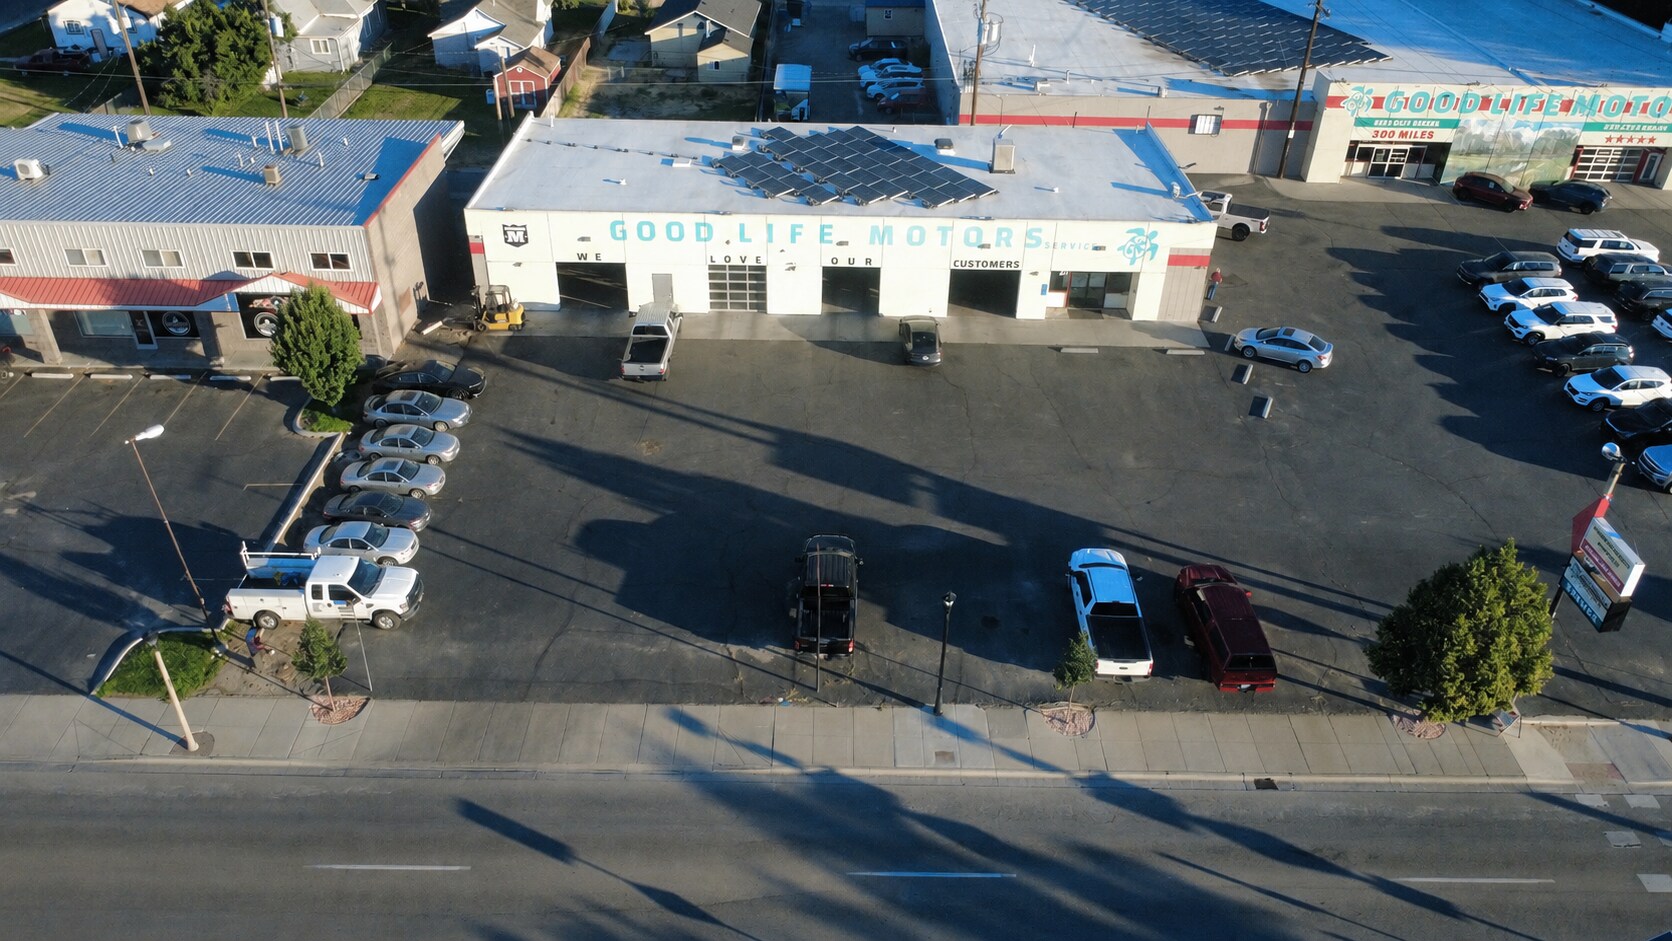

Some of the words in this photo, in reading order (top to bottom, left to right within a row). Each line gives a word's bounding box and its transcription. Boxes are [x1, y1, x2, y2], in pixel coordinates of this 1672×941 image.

[1385, 90, 1480, 114] GOOD
[1491, 93, 1562, 115] LIFE
[1372, 130, 1395, 138] 300
[1398, 130, 1434, 139] MILES
[609, 219, 714, 242] GOOD
[738, 223, 833, 245] LIFE
[869, 226, 1041, 248] MOTORS
[577, 252, 603, 263] WE
[710, 255, 763, 265] LOVE
[831, 257, 872, 267] OUR
[953, 260, 1020, 269] CUSTOMERS
